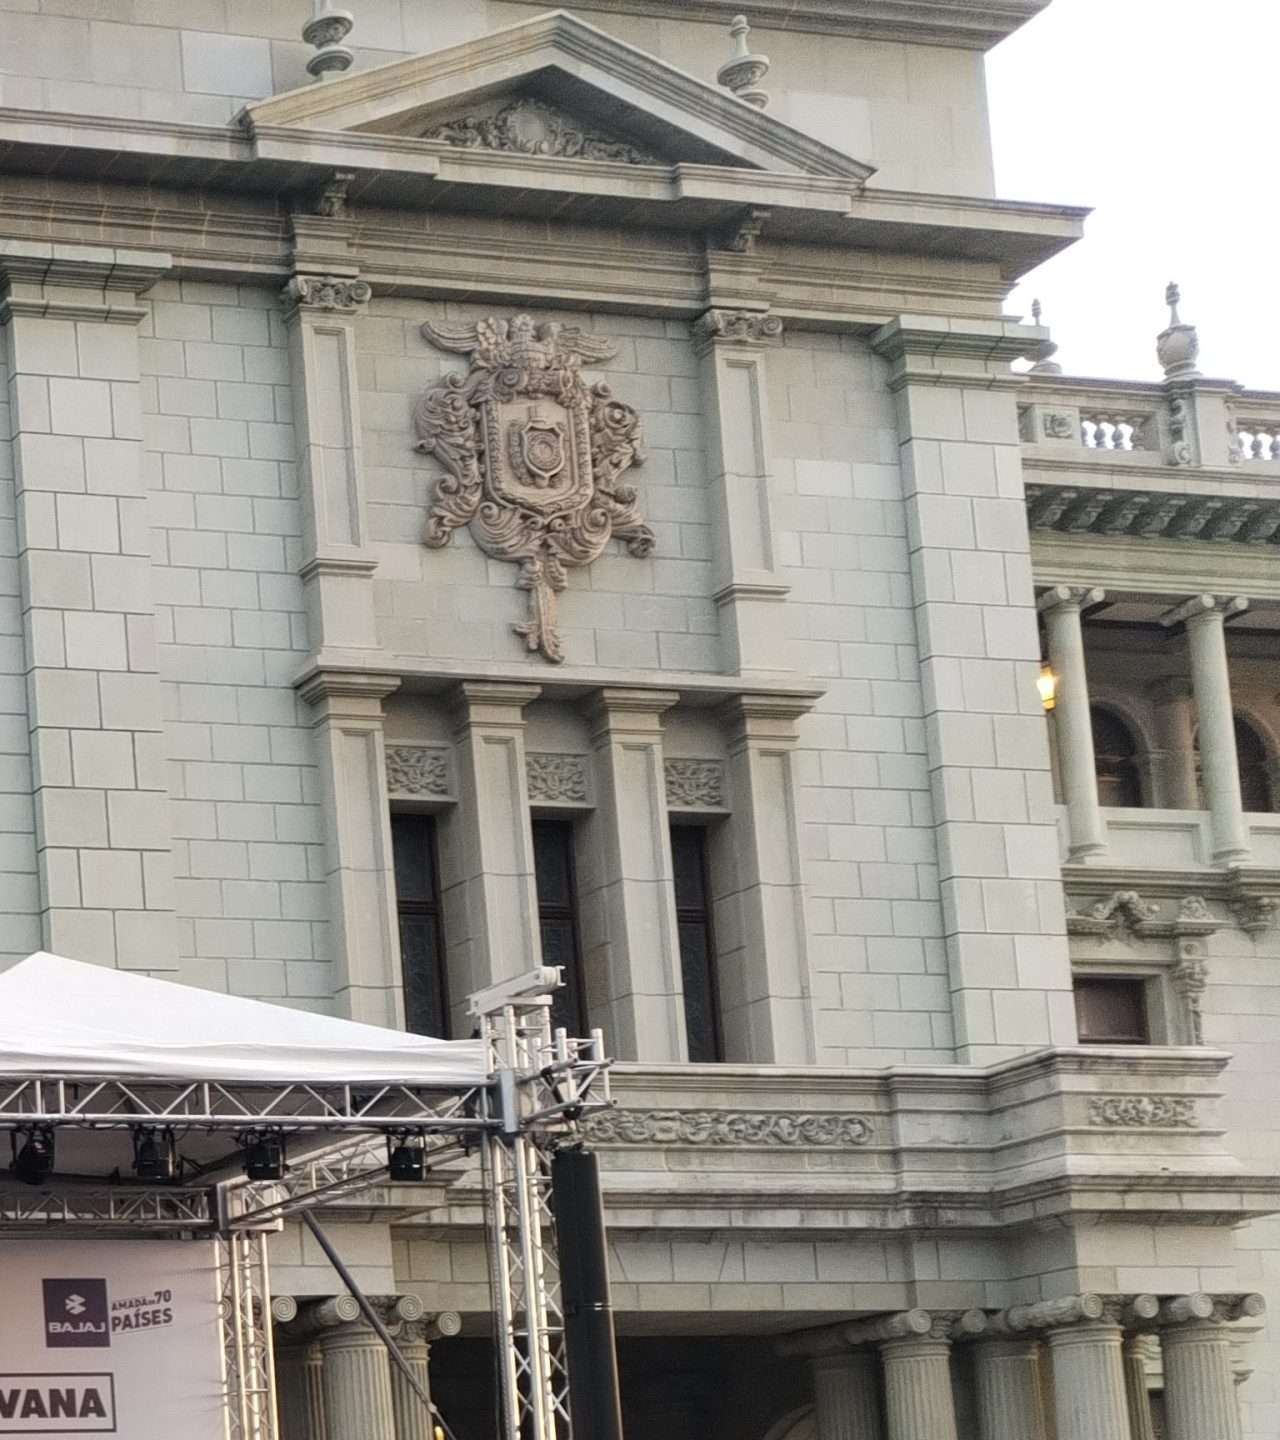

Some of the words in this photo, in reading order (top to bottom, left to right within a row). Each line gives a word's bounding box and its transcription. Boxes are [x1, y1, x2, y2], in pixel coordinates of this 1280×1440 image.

[154, 1289, 172, 1305] 70
[48, 1321, 107, 1333] BAJAJ
[111, 1307, 173, 1332] PAÍSES
